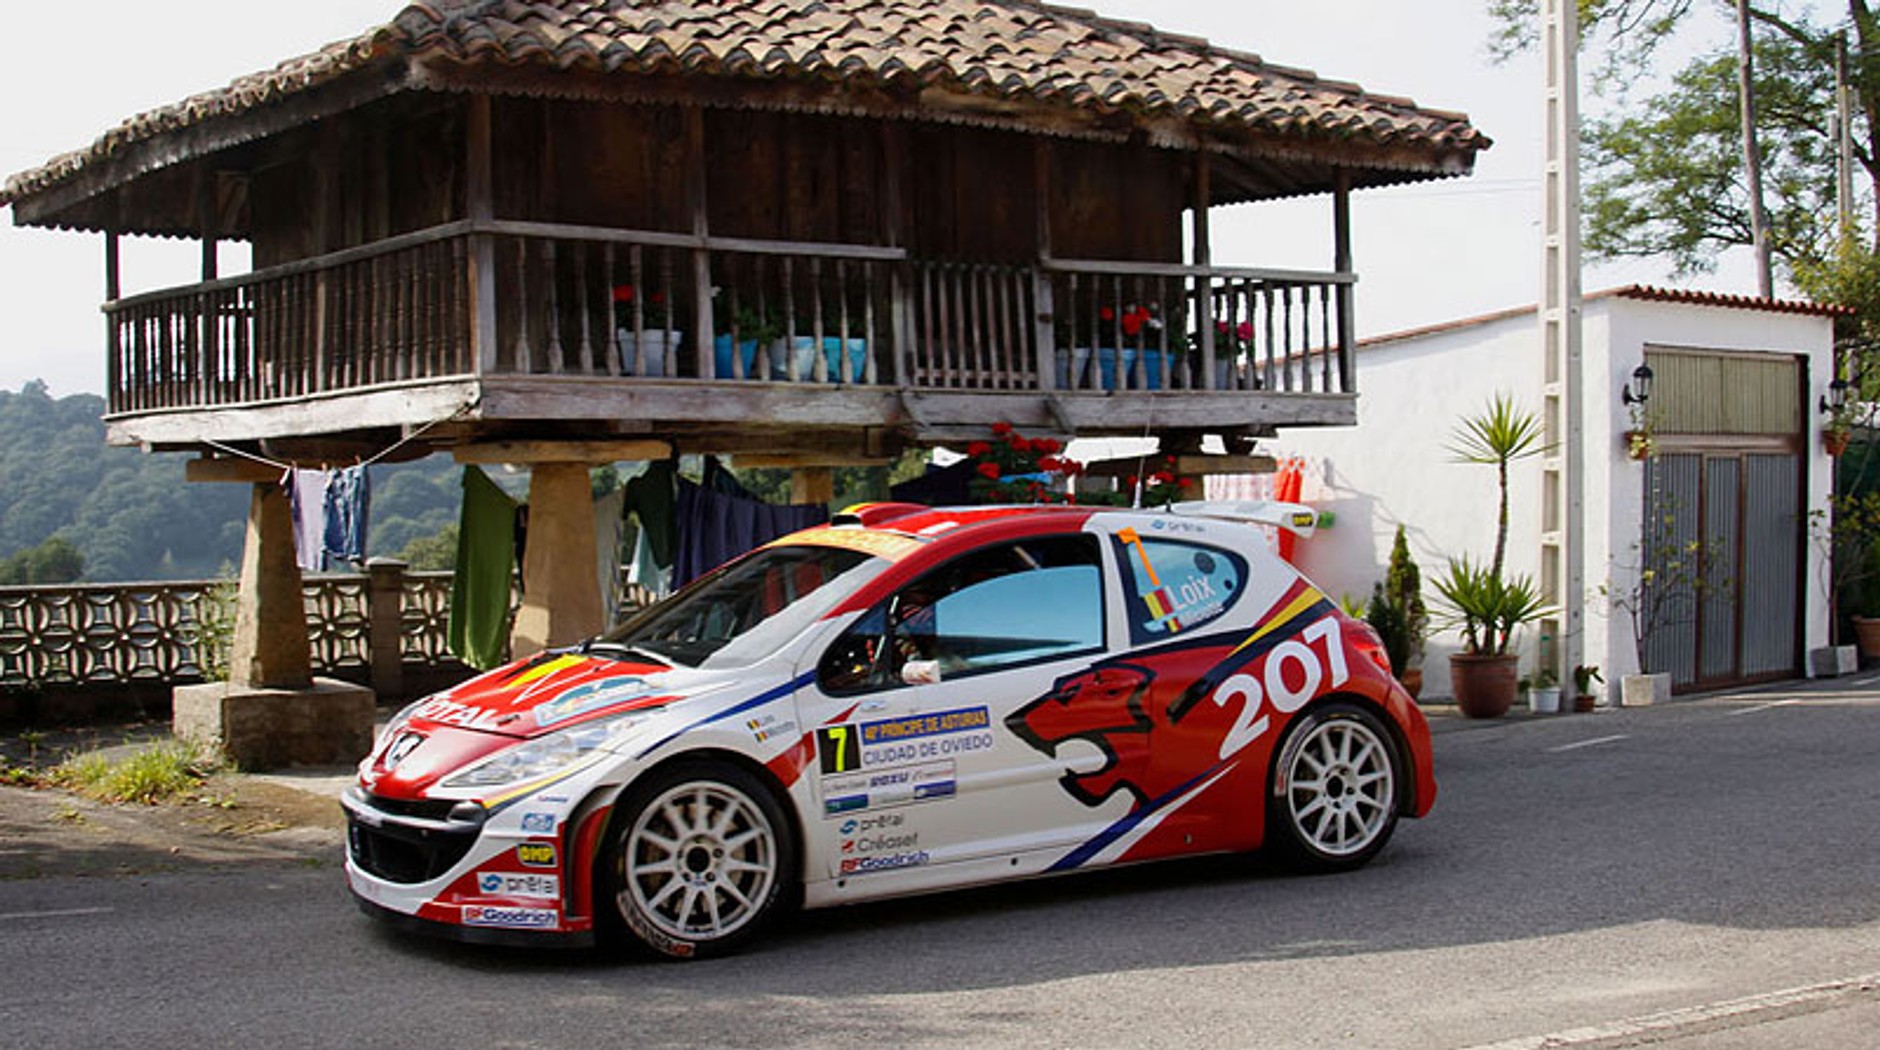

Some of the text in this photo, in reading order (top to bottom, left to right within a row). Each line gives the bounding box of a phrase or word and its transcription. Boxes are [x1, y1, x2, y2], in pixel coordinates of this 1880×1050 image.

[1166, 575, 1216, 610] Loix
[1212, 615, 1350, 761] 207
[926, 717, 939, 732] DE
[941, 710, 986, 729] ASTURIAS
[828, 727, 847, 772] 7
[863, 733, 993, 766] CIUDAD DE OVIEDO
